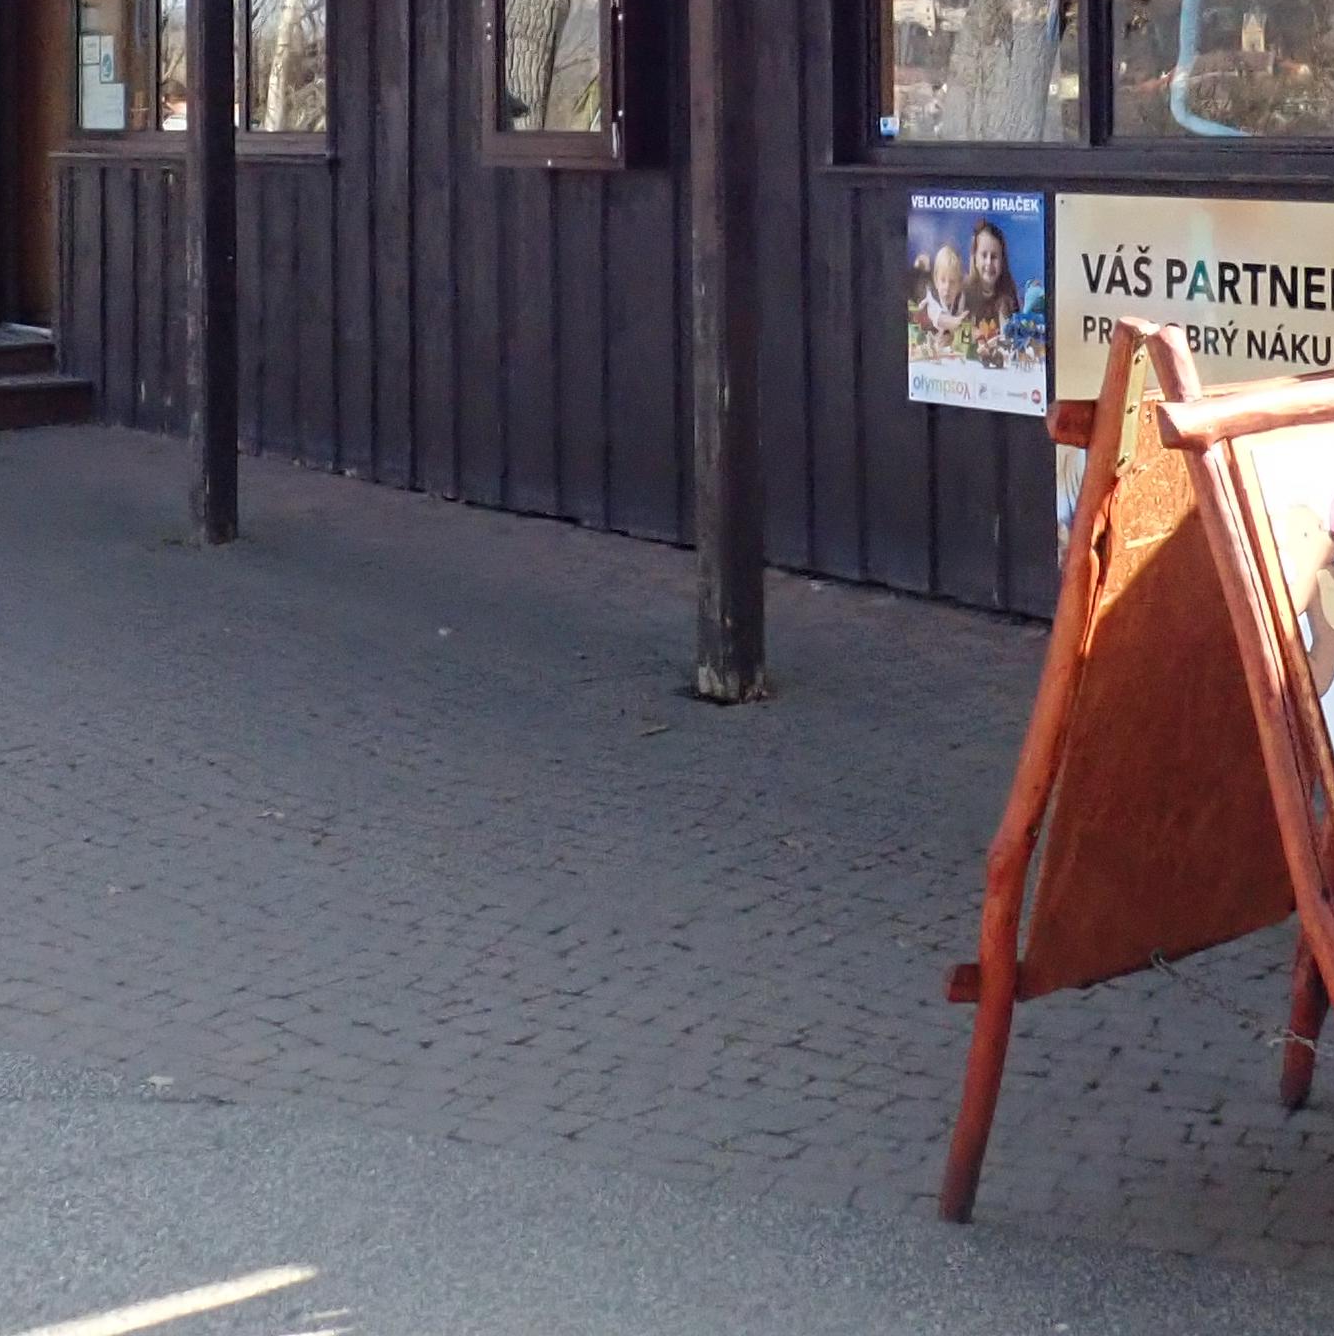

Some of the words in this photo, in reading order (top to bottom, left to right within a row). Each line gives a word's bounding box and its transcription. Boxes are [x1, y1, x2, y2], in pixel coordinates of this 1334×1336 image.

[911, 195, 990, 211] VELKOOBCHOD
[992, 196, 1040, 213] HRAČEK
[1081, 244, 1153, 298] VÁŠ
[1083, 314, 1114, 345] PR
